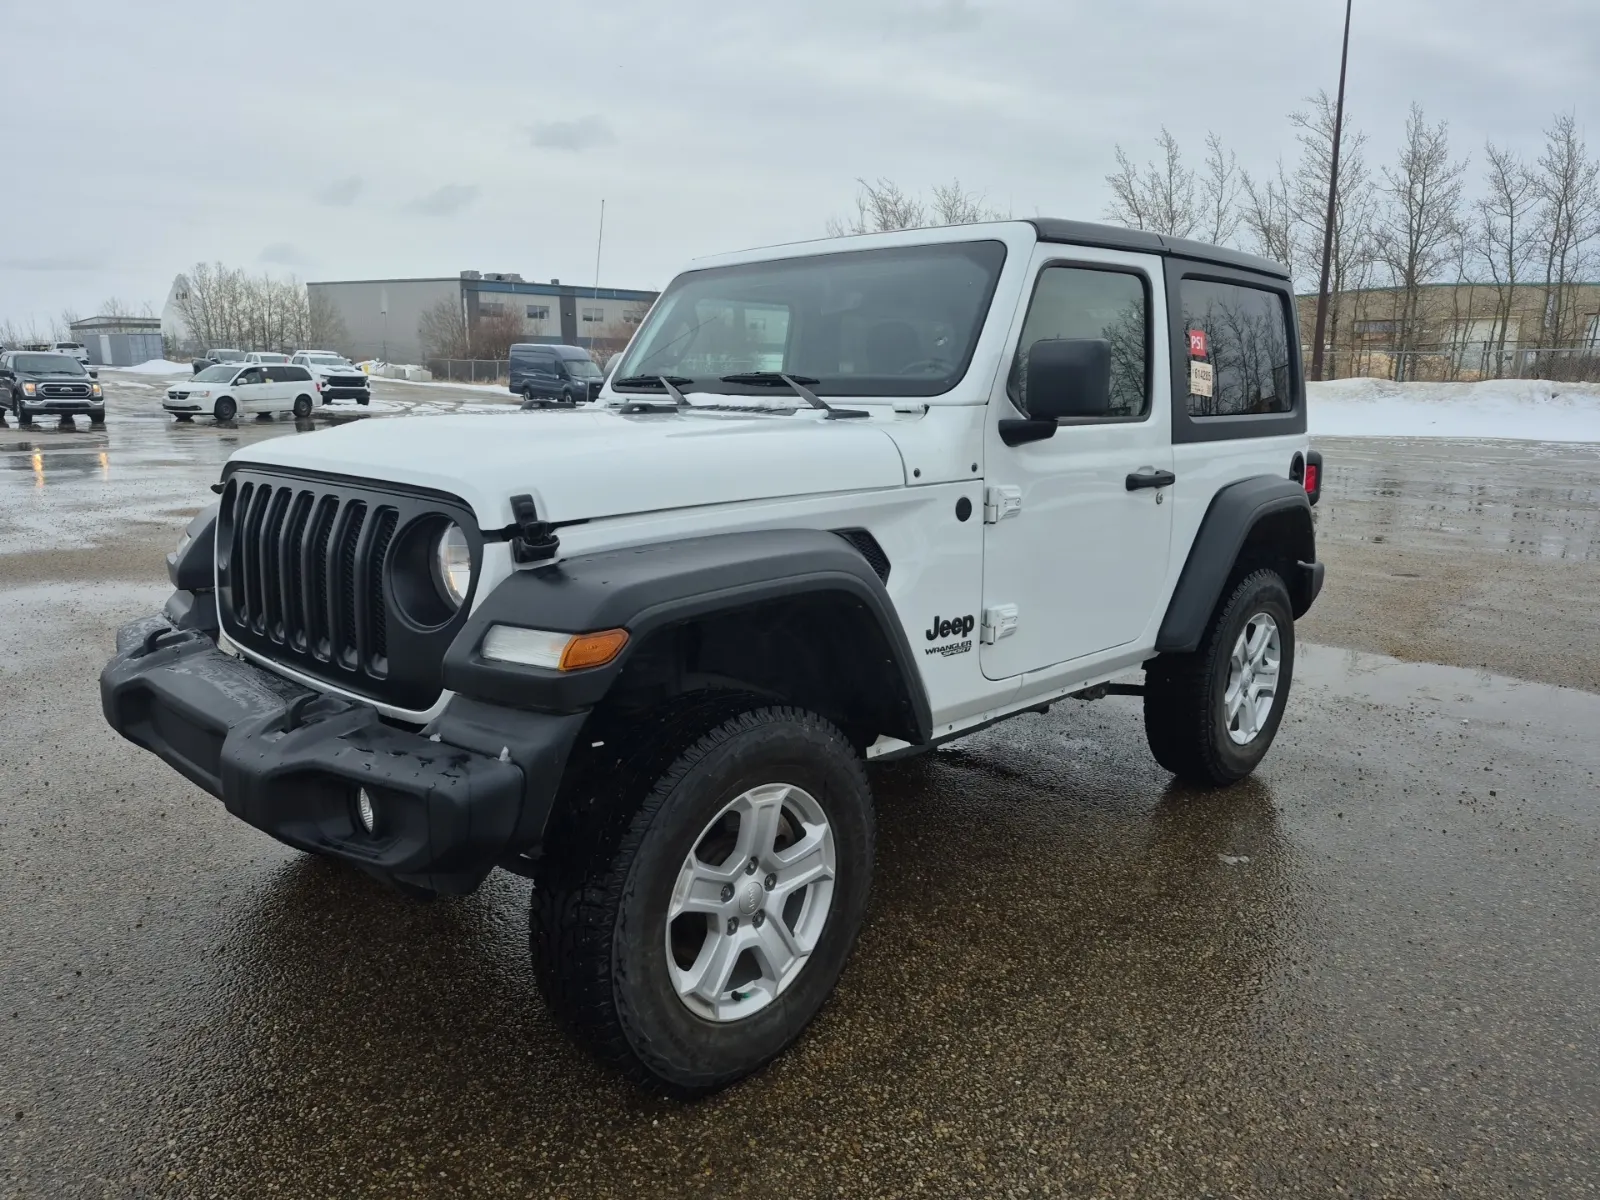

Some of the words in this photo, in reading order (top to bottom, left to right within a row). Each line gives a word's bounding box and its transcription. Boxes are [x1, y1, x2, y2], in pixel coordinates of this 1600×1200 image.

[1191, 335, 1203, 350] PSI
[925, 614, 975, 641] Jeep
[925, 640, 972, 655] WRANGLER
